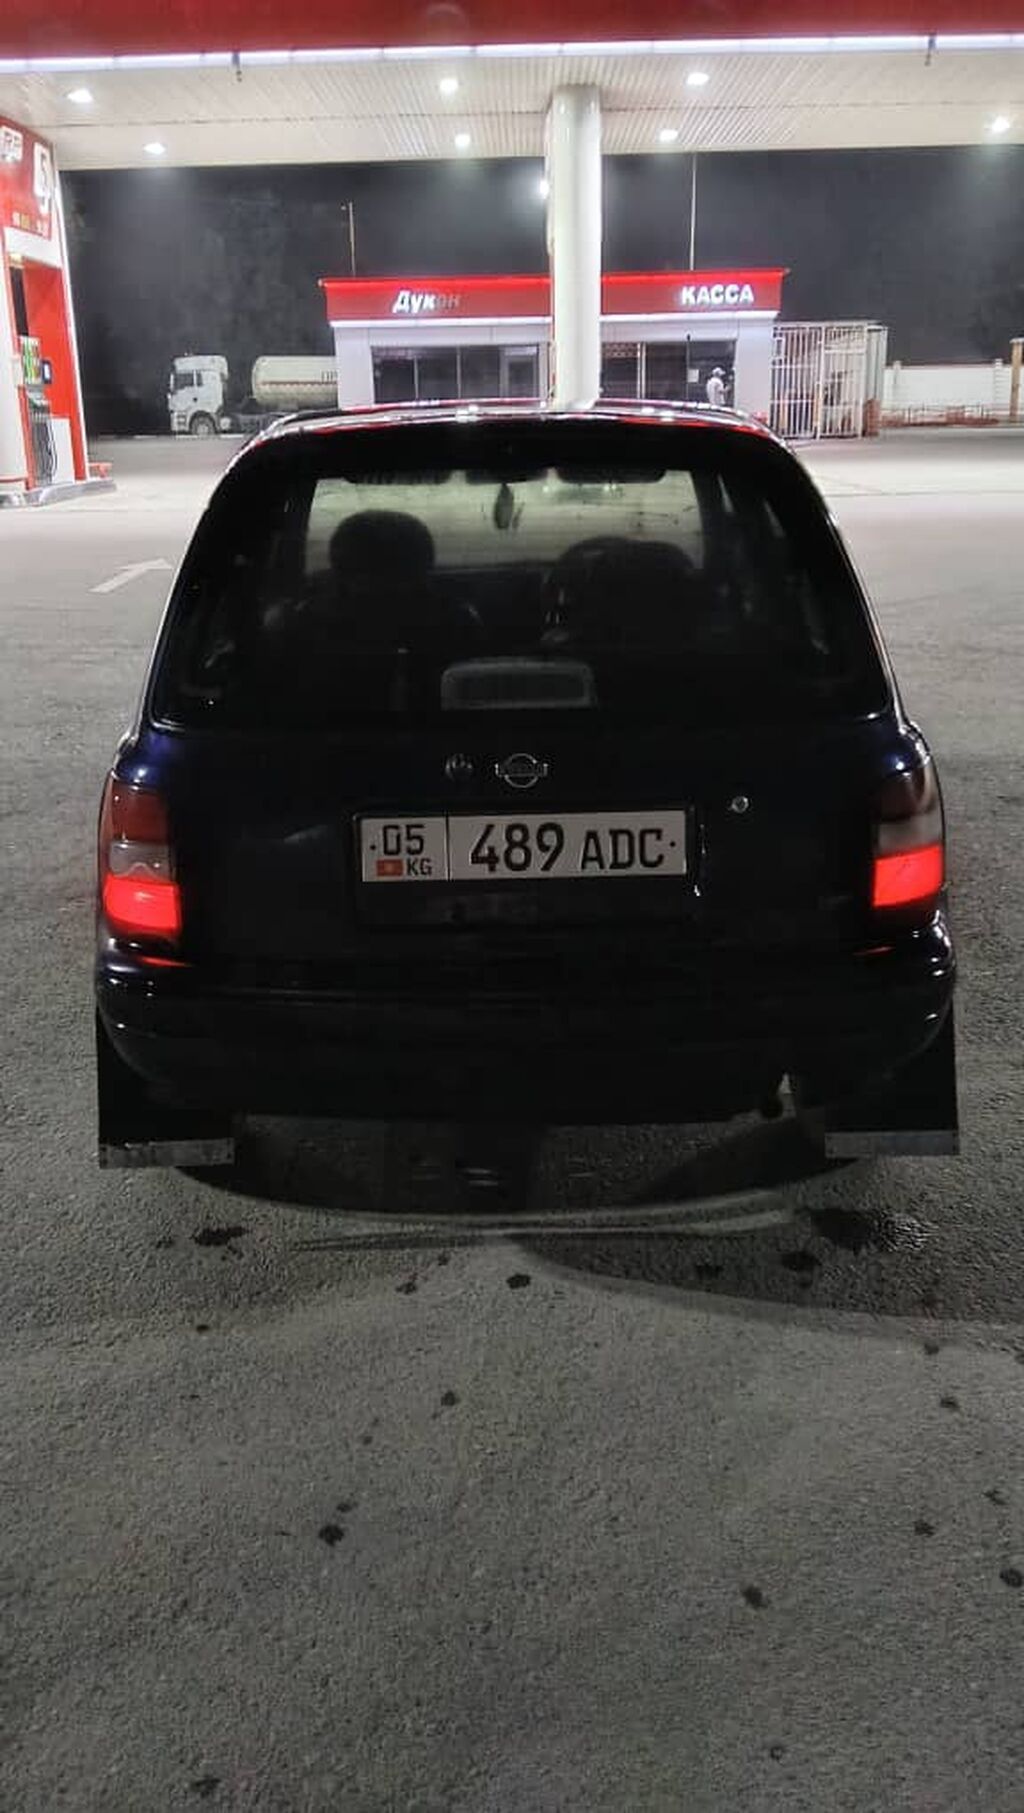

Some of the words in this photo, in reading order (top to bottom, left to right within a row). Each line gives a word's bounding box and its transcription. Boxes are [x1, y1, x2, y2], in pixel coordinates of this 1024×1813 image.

[681, 284, 754, 305] КАССА
[382, 825, 424, 856] 05
[471, 823, 564, 873] 489
[581, 828, 664, 870] ADC
[406, 858, 432, 876] KG
